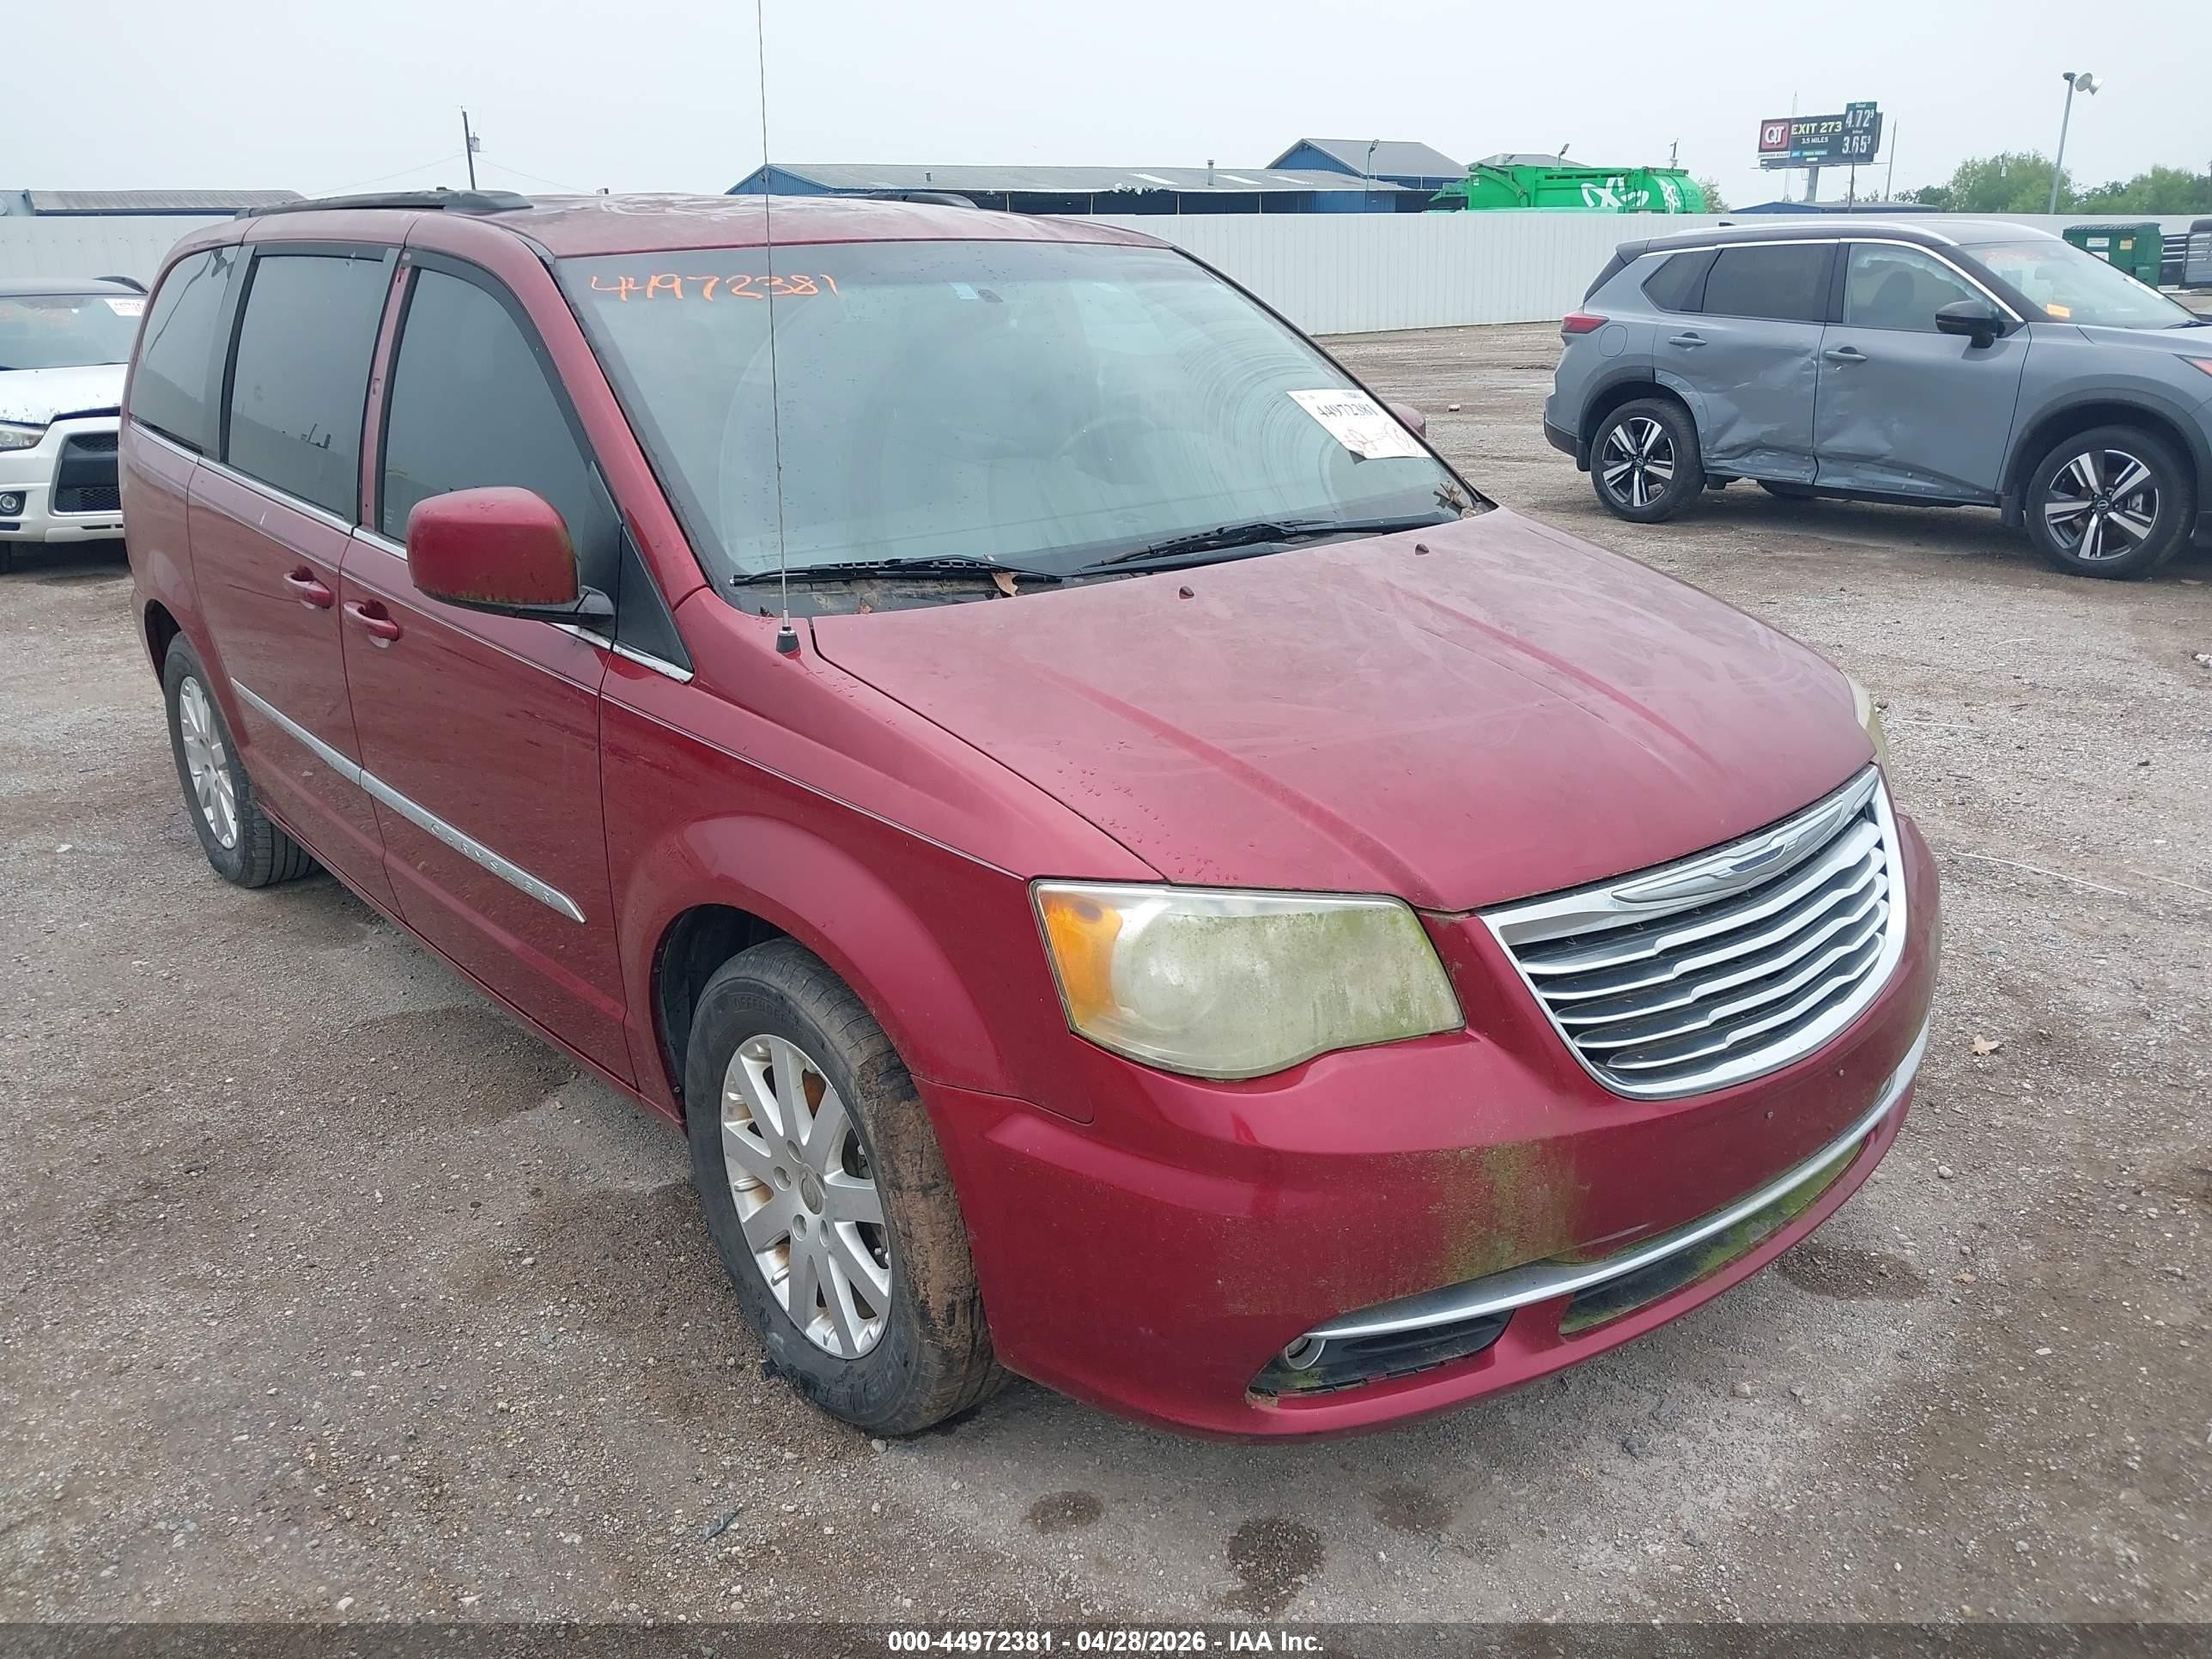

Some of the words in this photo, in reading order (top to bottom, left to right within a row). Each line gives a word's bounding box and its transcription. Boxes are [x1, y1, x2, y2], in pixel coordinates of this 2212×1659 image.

[1765, 126, 1784, 145] QT
[1791, 123, 1817, 135] EXIT
[1820, 121, 1842, 133] 273
[590, 274, 841, 302] 44972381
[1316, 404, 1378, 417] 44972381
